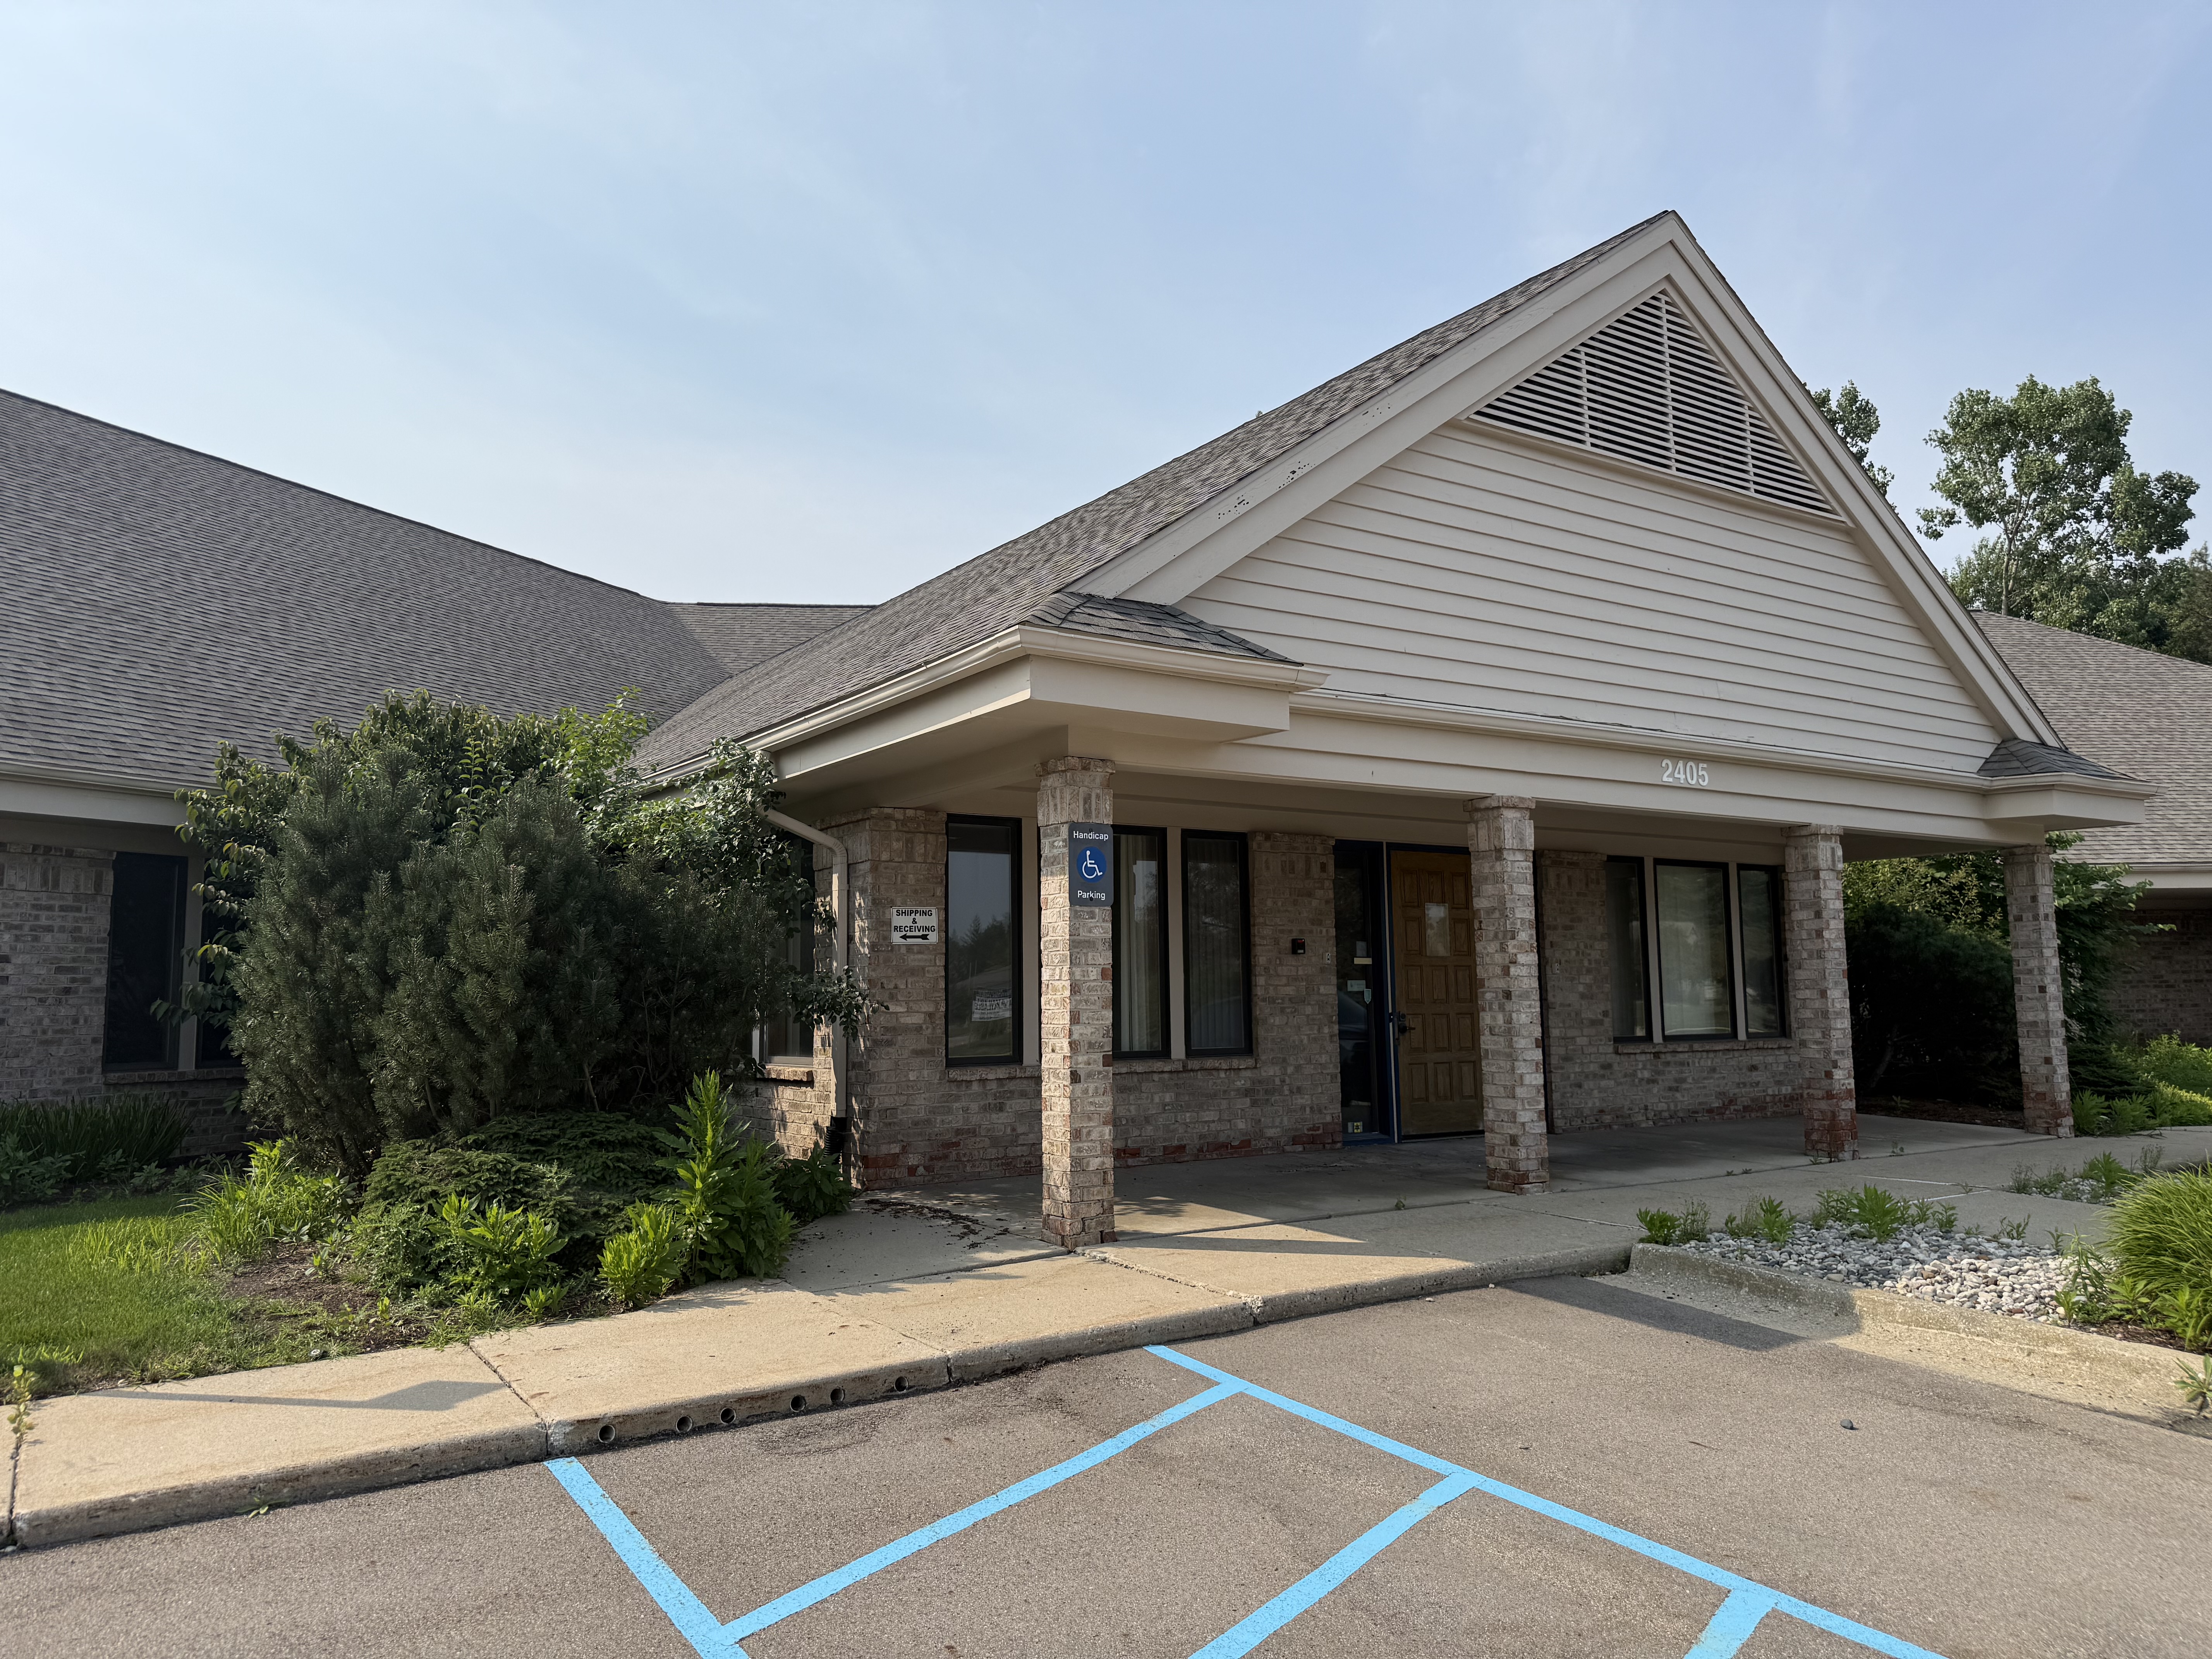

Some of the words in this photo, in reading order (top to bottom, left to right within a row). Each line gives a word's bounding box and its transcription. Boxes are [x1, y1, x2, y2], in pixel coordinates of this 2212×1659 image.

[1661, 759, 1709, 786] 2405
[1073, 831, 1109, 841] Handicap
[1078, 890, 1106, 900] Parking
